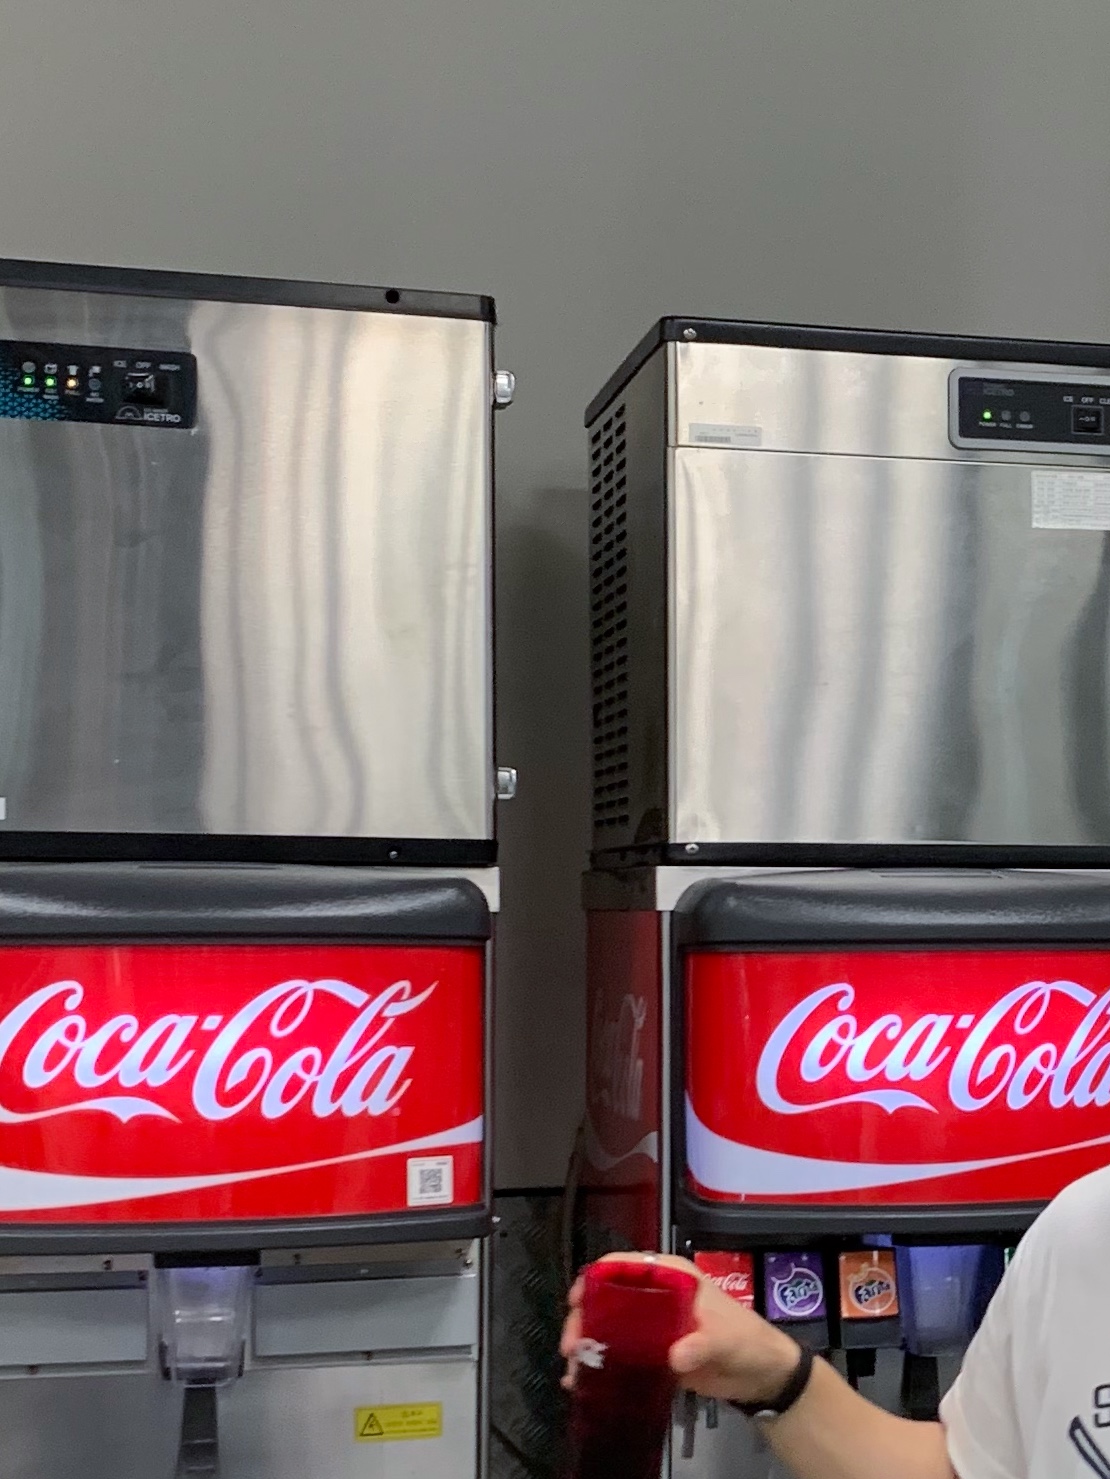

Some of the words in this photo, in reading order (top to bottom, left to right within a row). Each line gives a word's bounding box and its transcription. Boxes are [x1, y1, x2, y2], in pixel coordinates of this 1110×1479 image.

[143, 413, 182, 423] ICETRO
[779, 1280, 818, 1307] Fanta
[854, 1279, 892, 1305] Fanta
